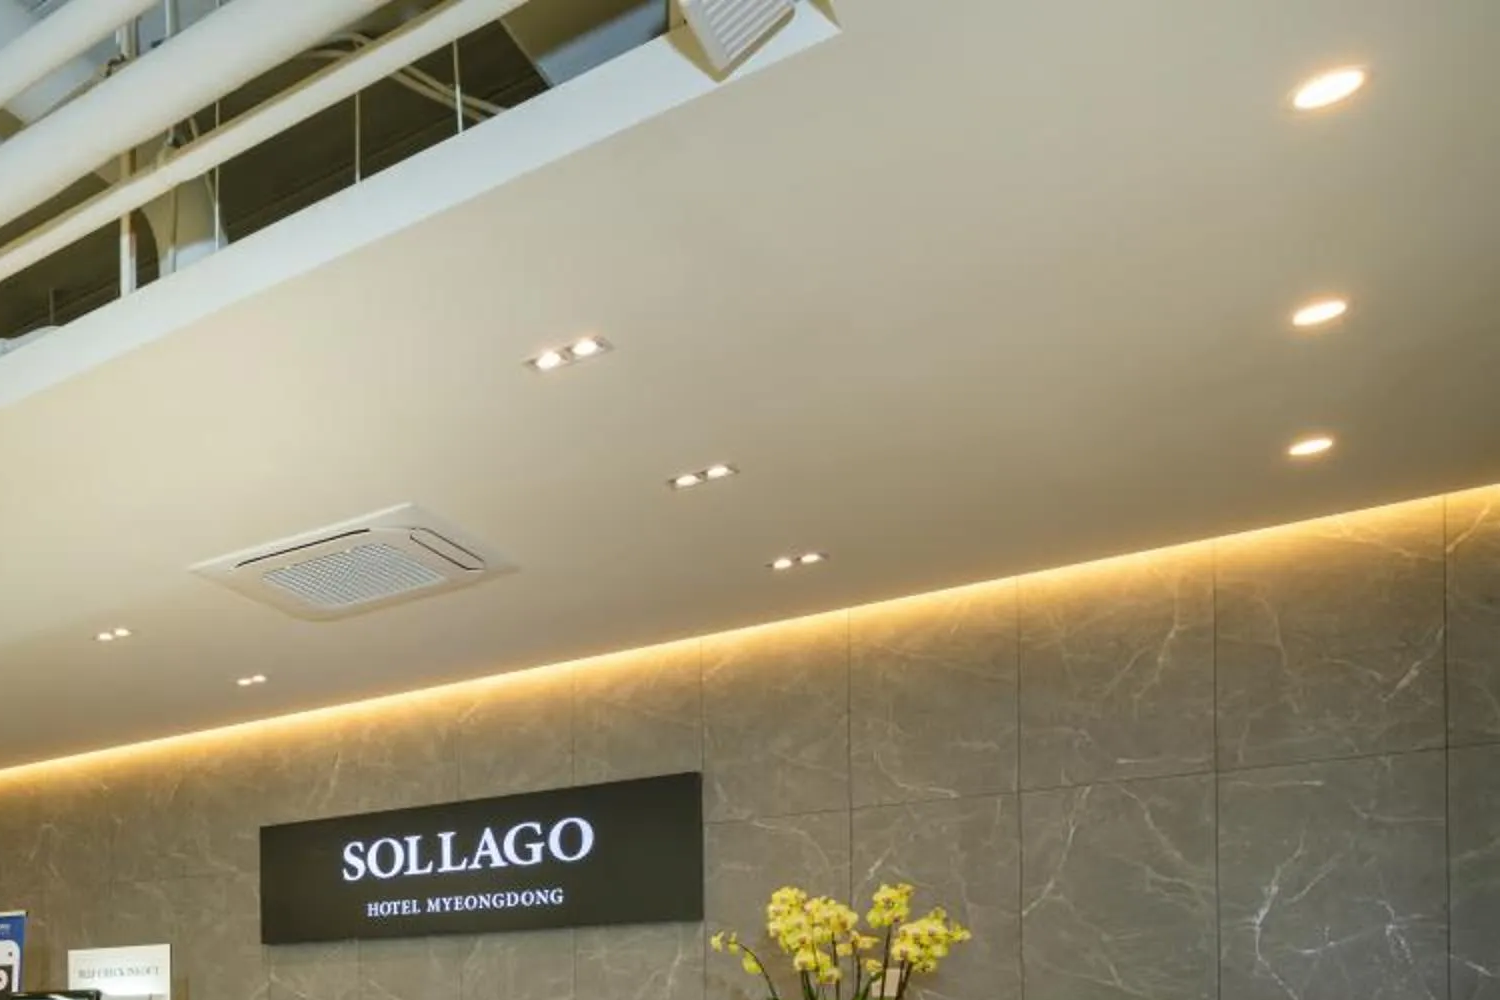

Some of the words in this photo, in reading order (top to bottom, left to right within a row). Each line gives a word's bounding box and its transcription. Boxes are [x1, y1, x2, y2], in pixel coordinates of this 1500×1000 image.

[342, 817, 595, 881] SOLLAGO
[366, 899, 421, 917] HOTEL
[426, 887, 565, 913] MYEONGDONG
